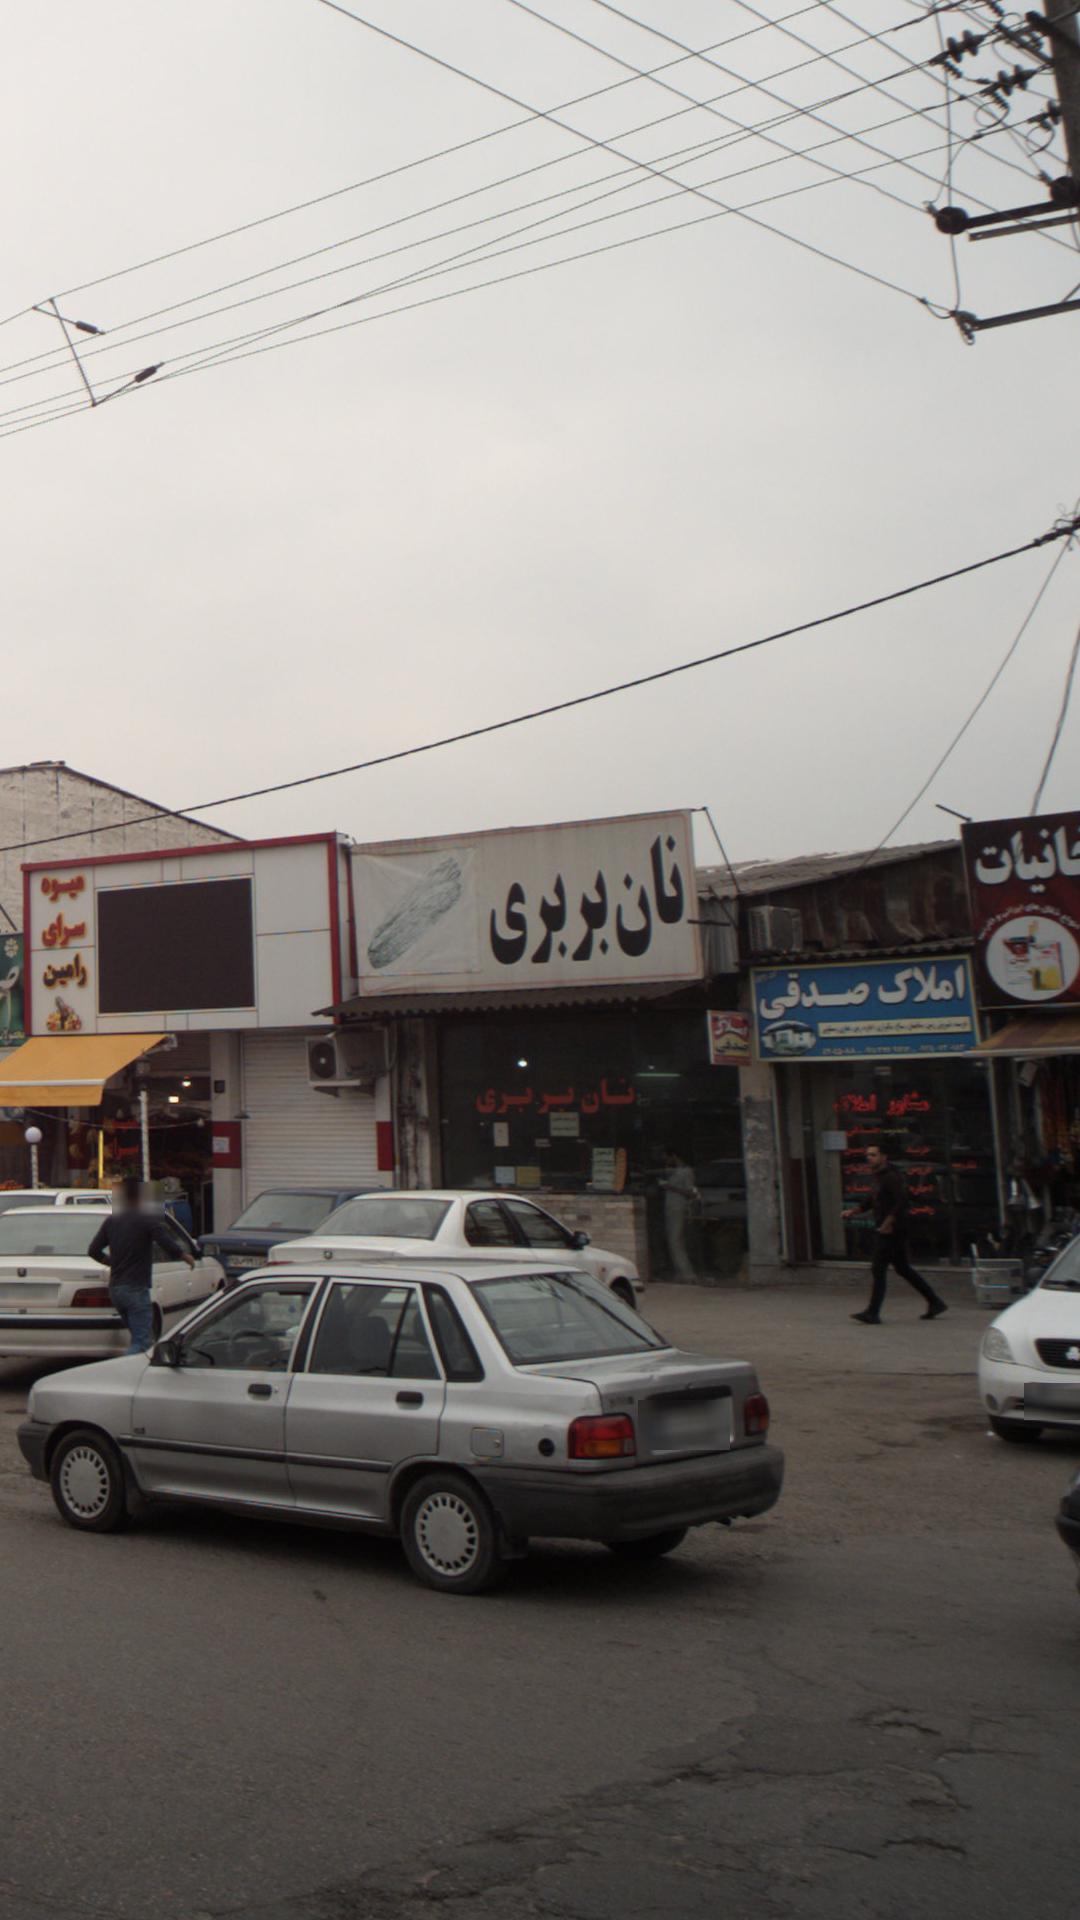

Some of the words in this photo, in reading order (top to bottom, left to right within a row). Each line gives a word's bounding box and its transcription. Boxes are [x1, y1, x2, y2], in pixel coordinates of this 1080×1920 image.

[41, 874, 85, 900] میوه
[616, 834, 685, 957] نان
[41, 913, 86, 948] سرای
[490, 870, 608, 965] بربری
[43, 953, 87, 988] رامین
[878, 964, 965, 1004] املاک
[759, 971, 870, 1020] صدقی
[475, 1087, 576, 1115] بربری
[578, 1076, 636, 1115] نان
